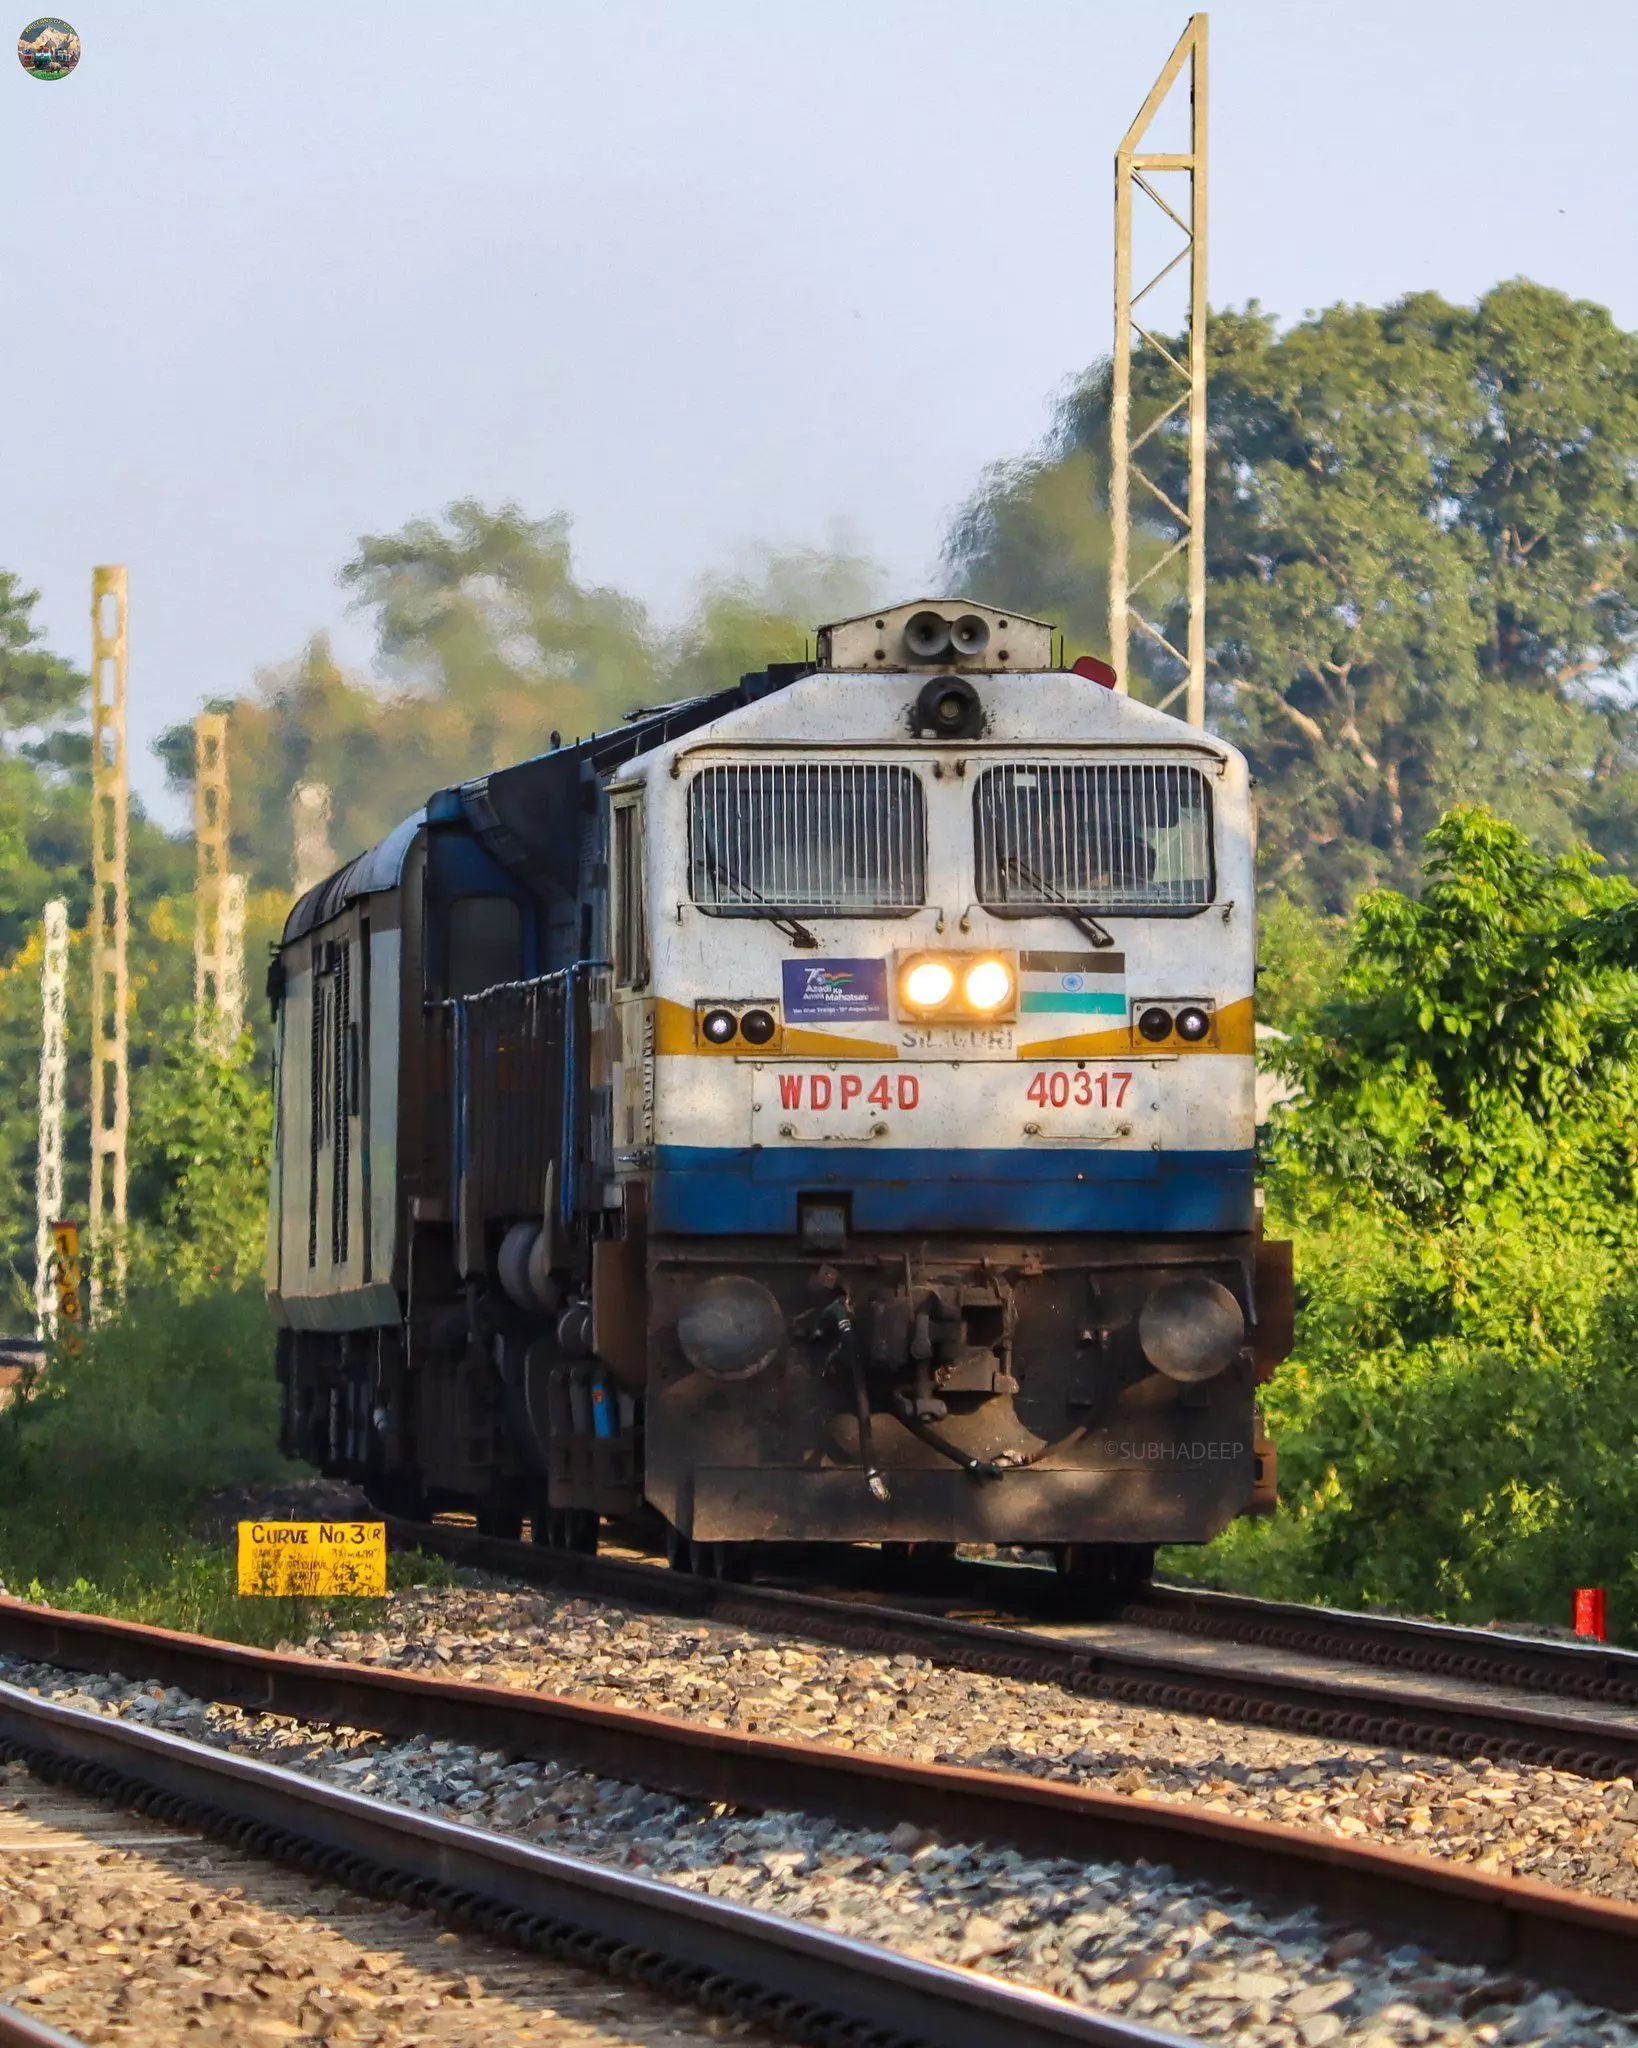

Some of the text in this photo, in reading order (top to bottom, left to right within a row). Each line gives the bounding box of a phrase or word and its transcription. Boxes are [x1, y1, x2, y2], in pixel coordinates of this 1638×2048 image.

[805, 984, 832, 993] Azadi
[825, 993, 869, 1002] Mahotsav
[778, 1071, 1133, 1111] WDP4D 40317
[252, 1524, 309, 1545] CURVE
